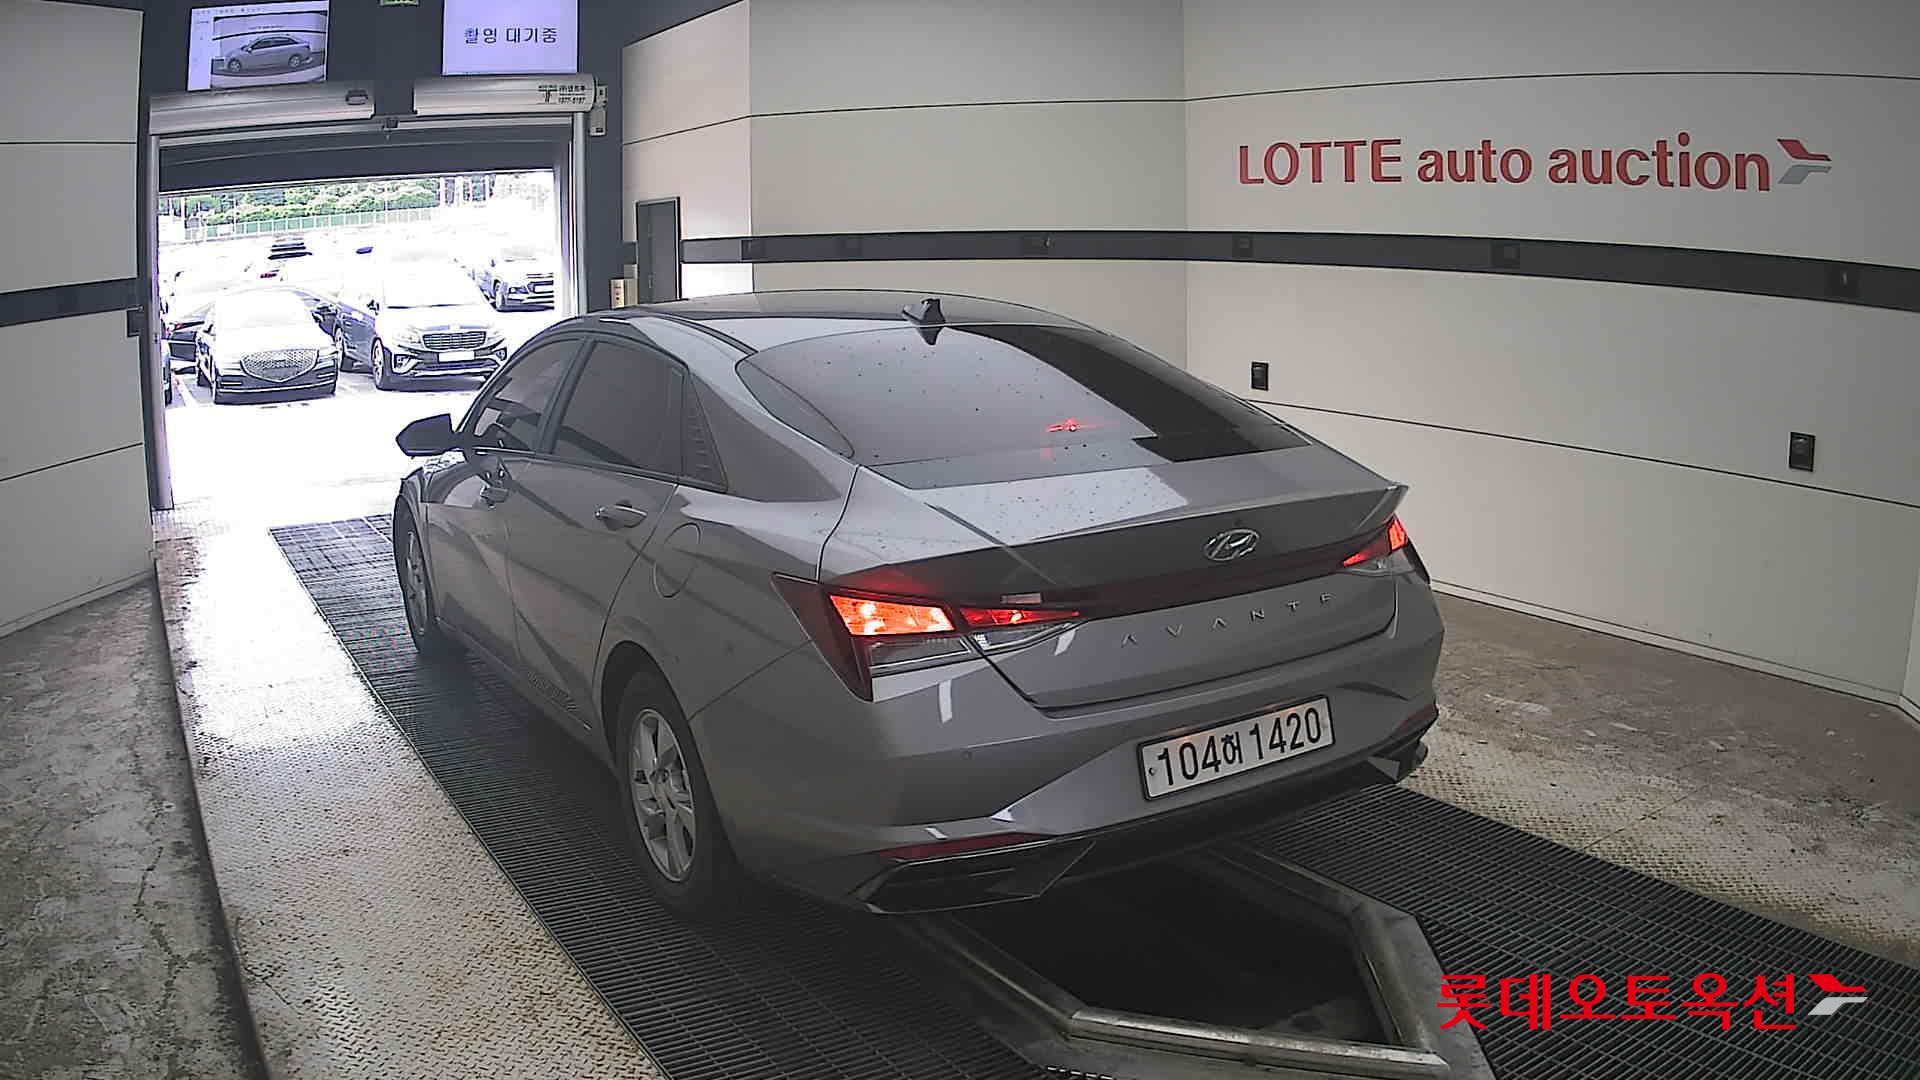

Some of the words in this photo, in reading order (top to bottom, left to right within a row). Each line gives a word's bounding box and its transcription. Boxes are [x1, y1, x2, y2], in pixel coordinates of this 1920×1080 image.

[505, 27, 558, 44] 대기중
[1238, 139, 1402, 185] LOTTE
[1417, 139, 1534, 184] auto
[1548, 132, 1771, 191] auction
[1157, 730, 1244, 786] 104허
[1248, 707, 1322, 761] 1420
